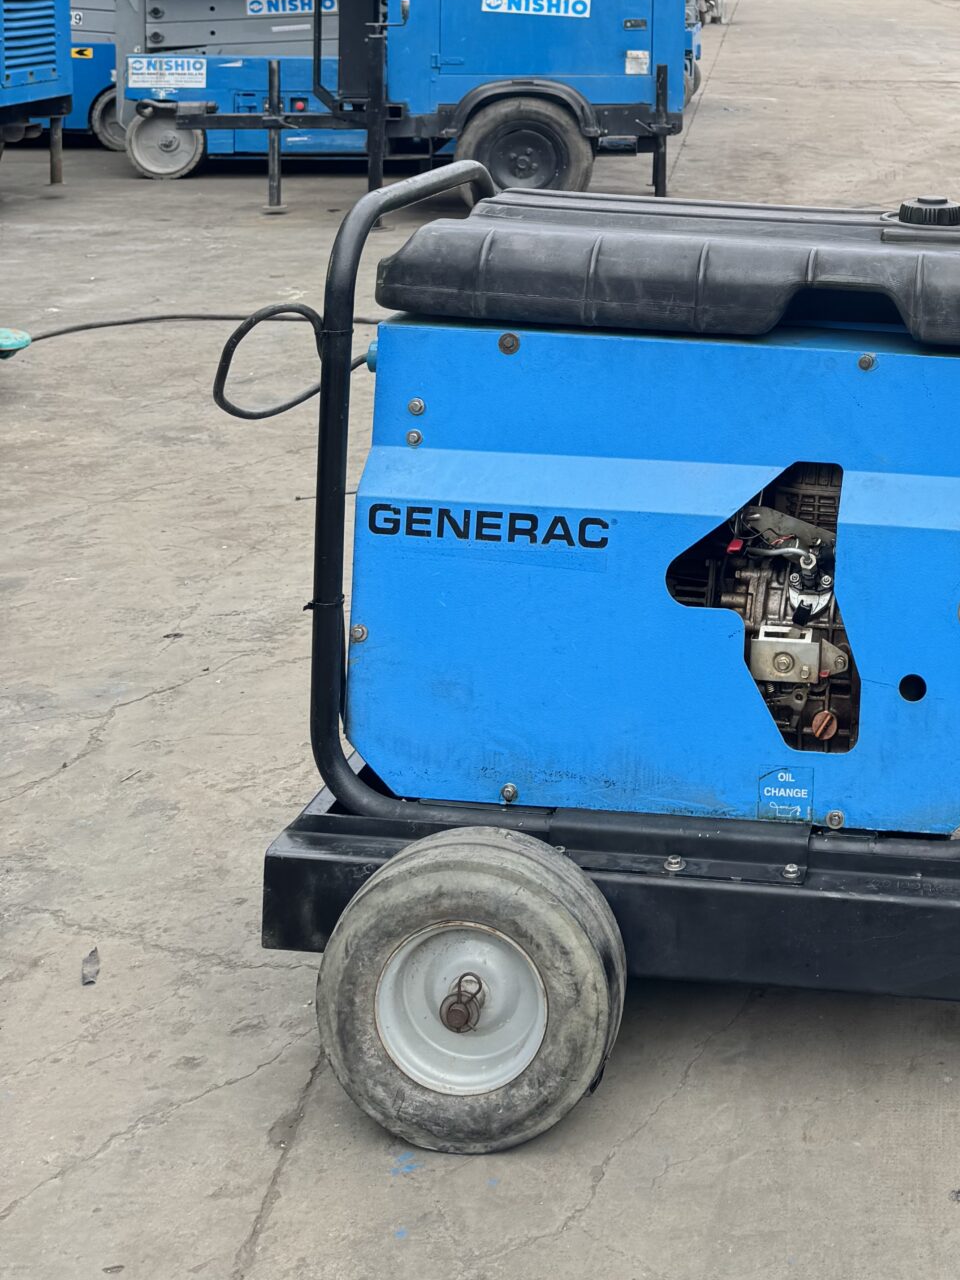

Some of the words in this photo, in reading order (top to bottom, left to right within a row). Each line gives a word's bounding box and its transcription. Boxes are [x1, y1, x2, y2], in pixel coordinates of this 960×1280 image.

[146, 60, 204, 71] NISHIO
[368, 503, 609, 549] GENERAC
[777, 772, 795, 782] OIL
[764, 787, 808, 798] CHANGE
